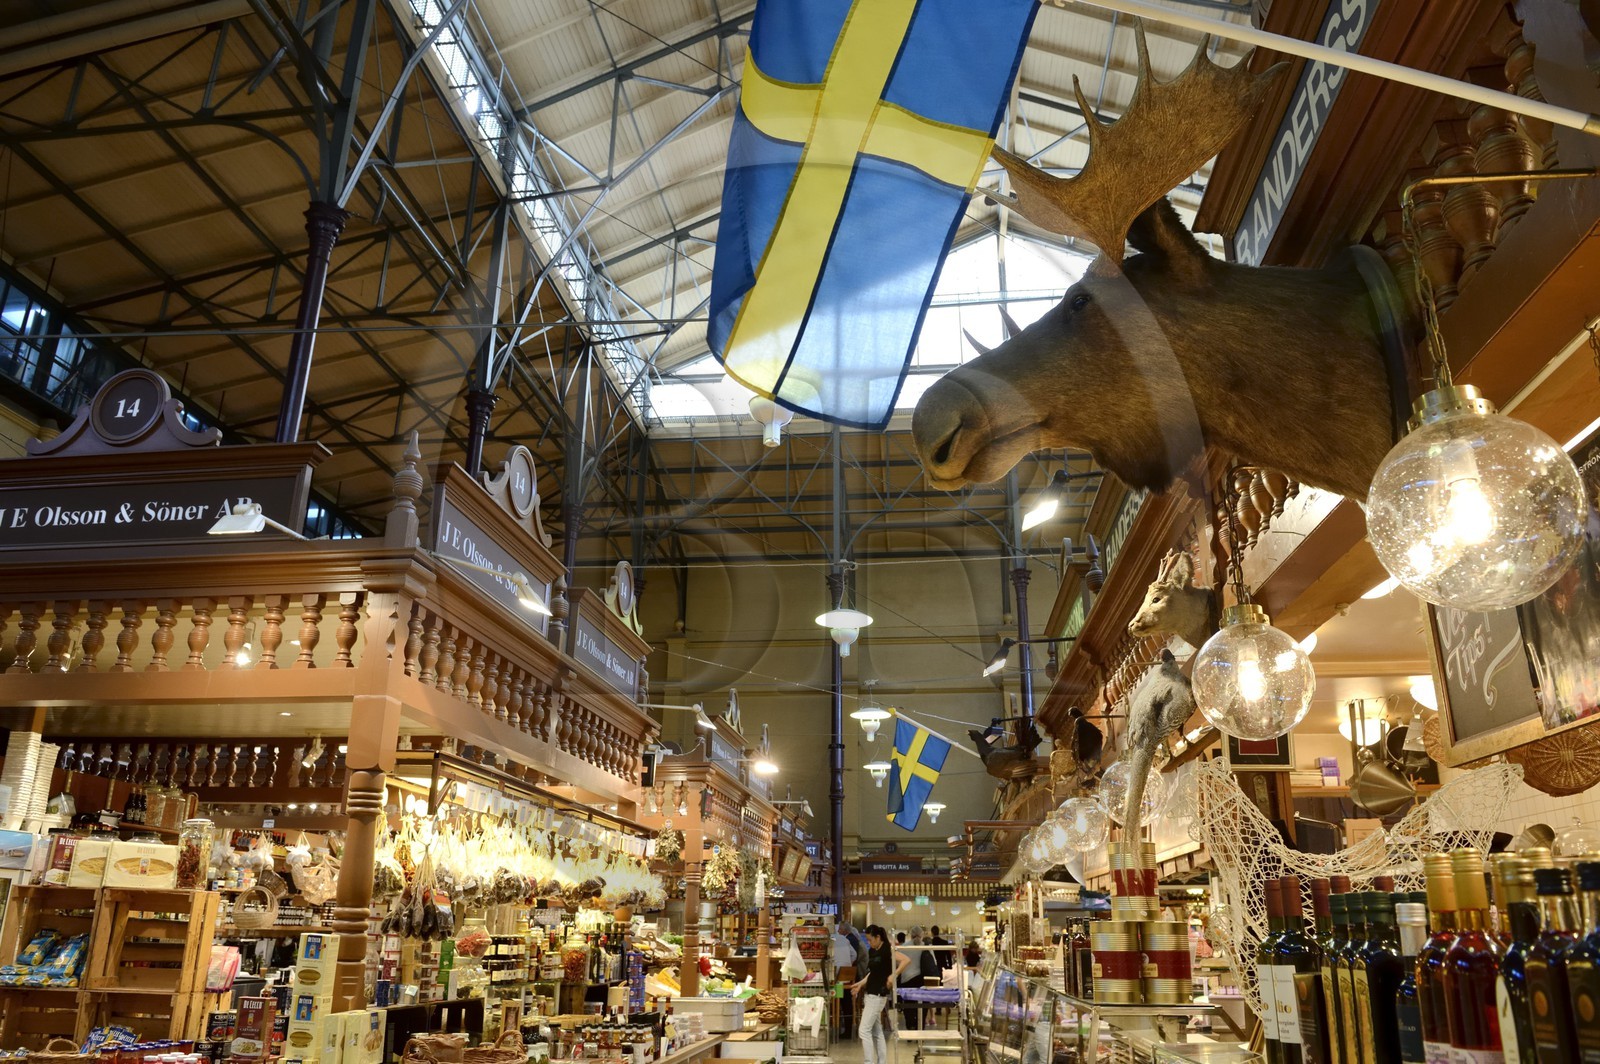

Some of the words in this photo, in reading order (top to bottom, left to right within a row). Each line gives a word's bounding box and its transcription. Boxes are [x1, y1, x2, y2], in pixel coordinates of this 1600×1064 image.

[114, 398, 141, 418] 14
[515, 472, 527, 495] 14
[9, 507, 29, 528] E
[34, 505, 106, 527] Olsson
[114, 502, 135, 524] &
[142, 501, 209, 522] Söner
[442, 520, 451, 543] J
[452, 529, 463, 552] E
[463, 537, 494, 577] Olsson
[620, 581, 628, 600] 14
[577, 629, 582, 647] J
[582, 633, 588, 650] E
[588, 639, 606, 665] Olsson
[606, 653, 612, 669] &
[612, 657, 626, 680] Söner
[626, 670, 634, 686] AB
